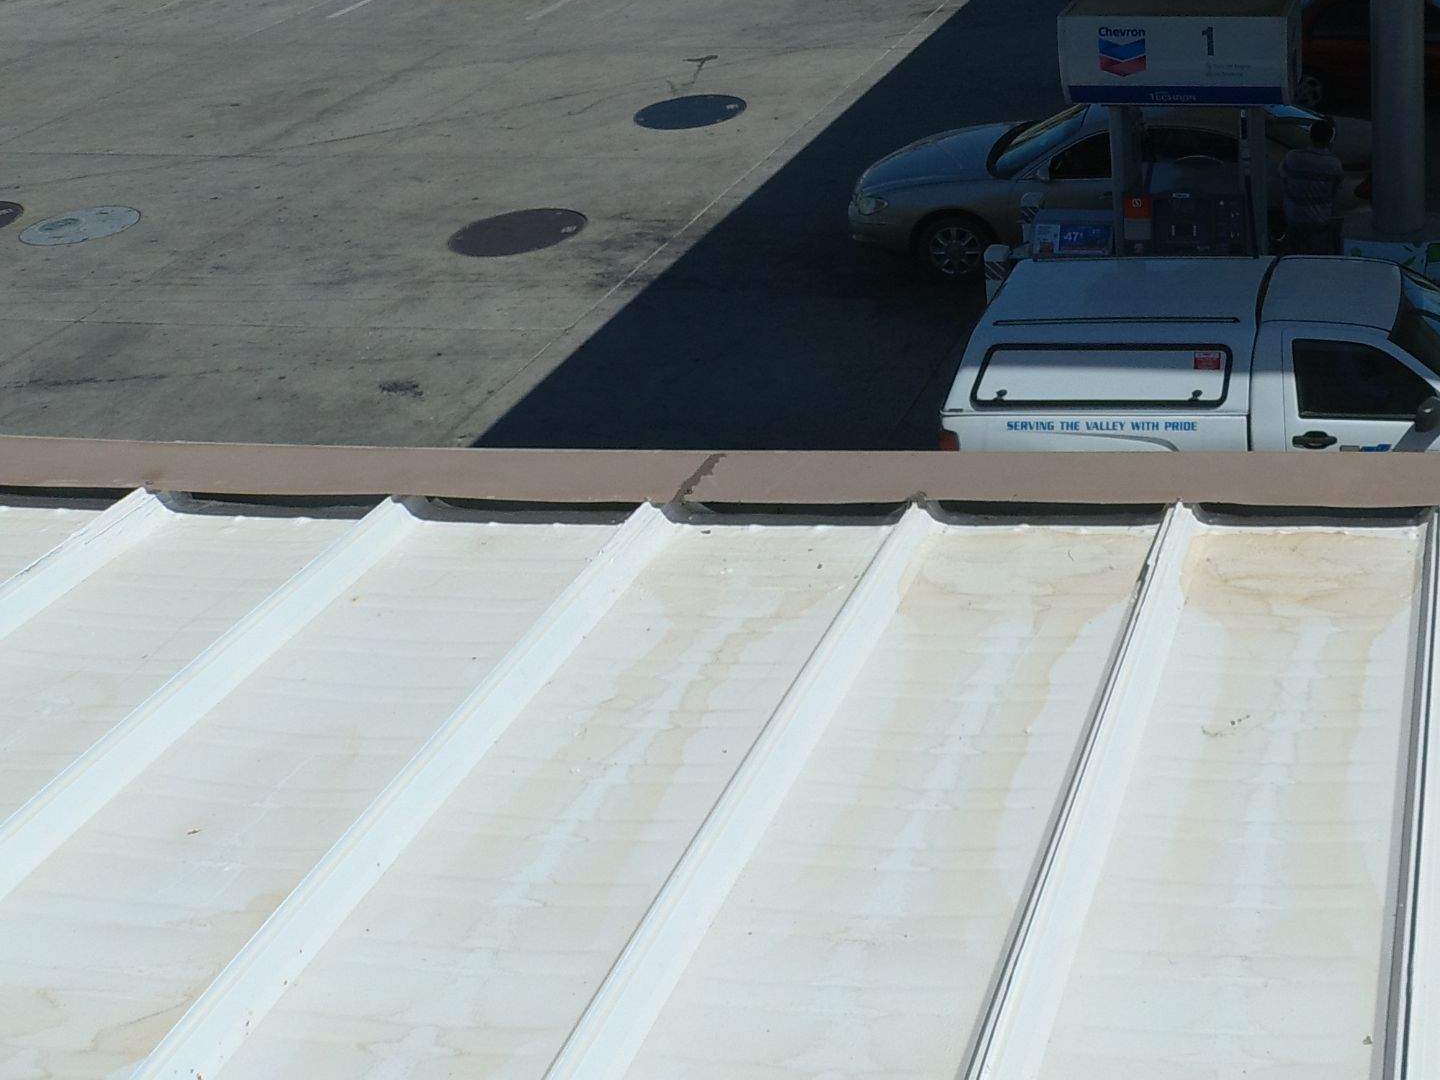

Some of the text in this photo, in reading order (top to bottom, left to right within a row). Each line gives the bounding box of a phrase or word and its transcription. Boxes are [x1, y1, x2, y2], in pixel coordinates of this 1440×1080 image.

[1098, 26, 1146, 38] Chevron
[1202, 26, 1215, 56] 1
[1006, 420, 1198, 431] SERVING THE VALLEY WITH PRIDE
